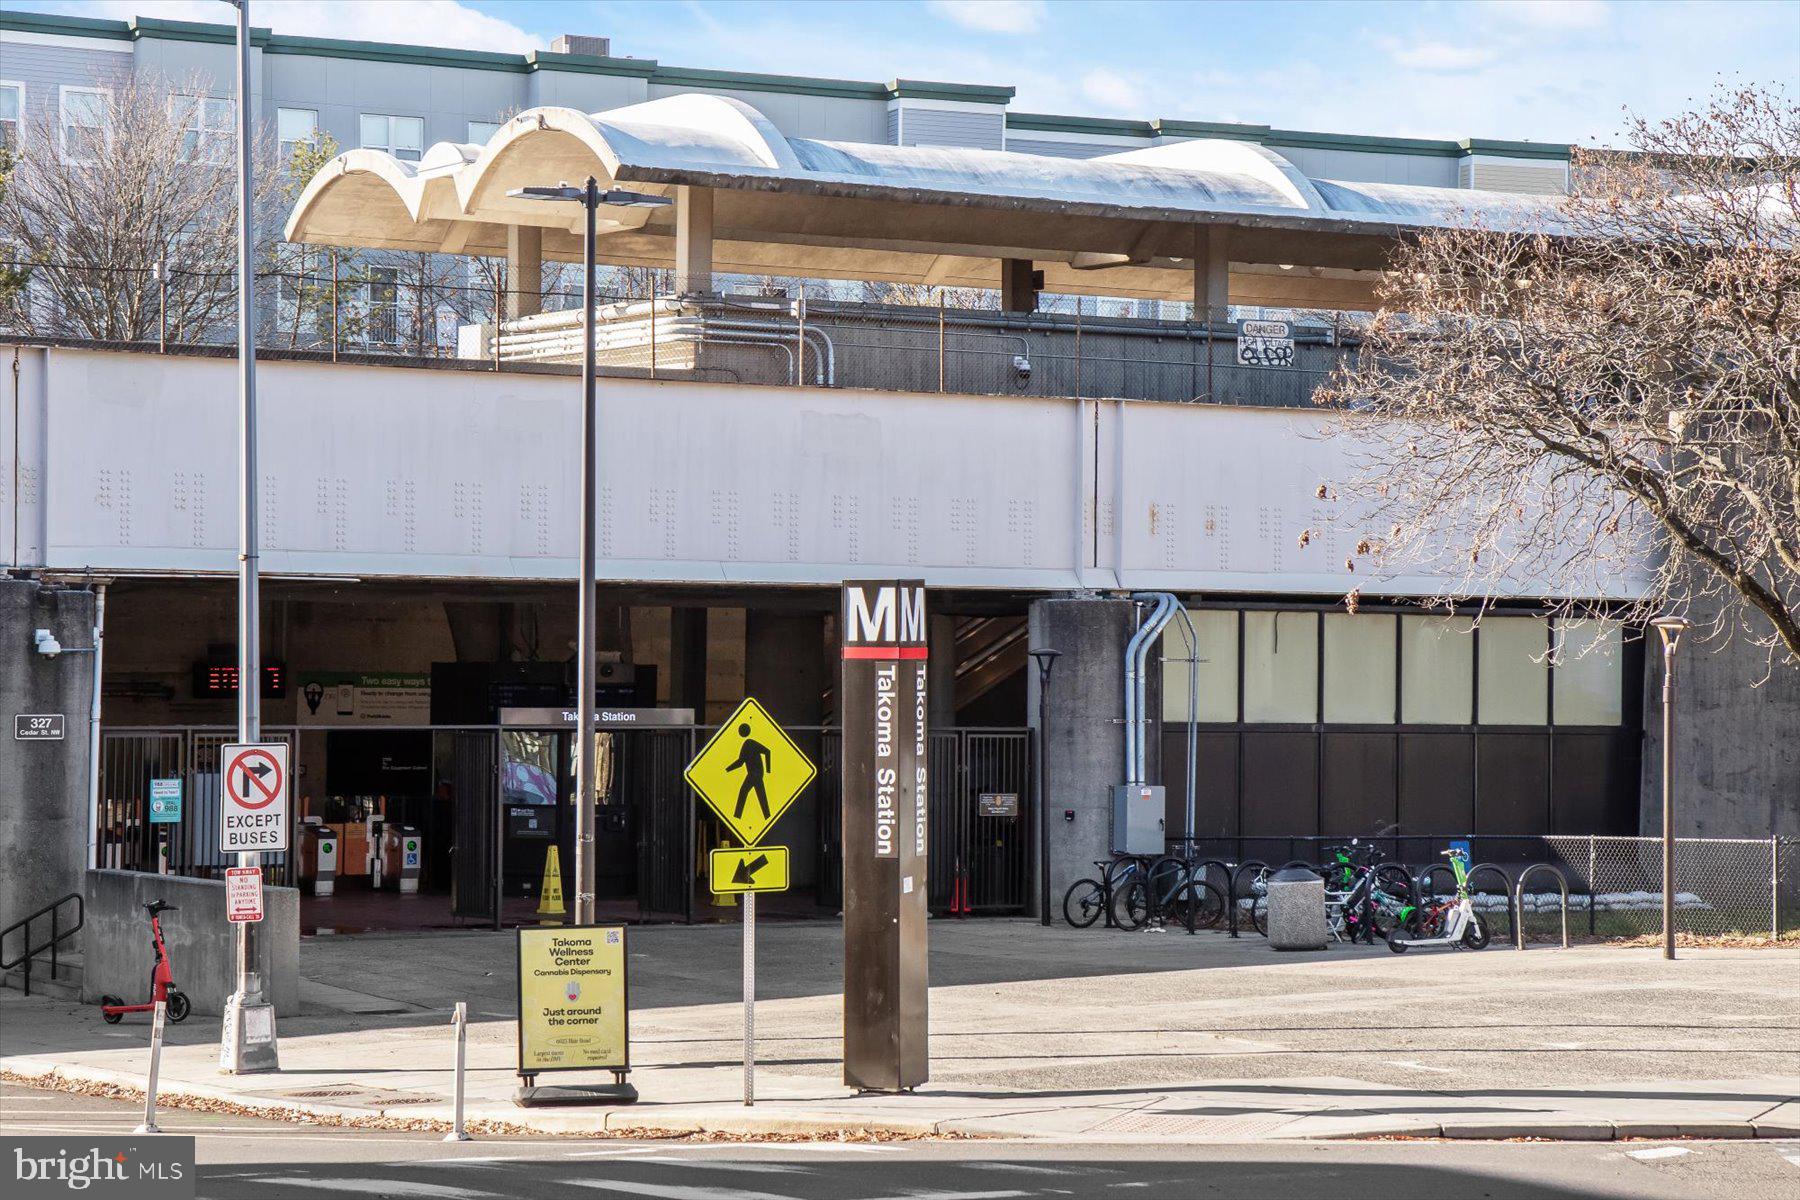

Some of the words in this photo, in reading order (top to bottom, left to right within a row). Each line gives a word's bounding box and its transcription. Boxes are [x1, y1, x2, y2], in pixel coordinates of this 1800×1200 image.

[1246, 324, 1286, 334] DANGER
[847, 587, 896, 642] M
[900, 587, 925, 642] M
[361, 676, 379, 686] Two
[382, 678, 401, 688] easy
[403, 678, 425, 688] ways
[562, 712, 600, 720] Taka
[602, 712, 636, 720] Station
[878, 665, 896, 757] Takoma
[917, 665, 926, 756] Takoma
[30, 718, 52, 728] 327
[878, 768, 896, 855] Station
[917, 768, 926, 853] Station
[227, 814, 281, 828] EXCEPT
[230, 831, 278, 844] BUSES
[552, 938, 592, 946] Takoma
[549, 948, 594, 956] Wellness
[555, 958, 590, 966] Center
[570, 968, 611, 976] Dispensary
[543, 1008, 565, 1016] Just
[566, 1006, 601, 1015] around
[548, 1018, 564, 1026] the
